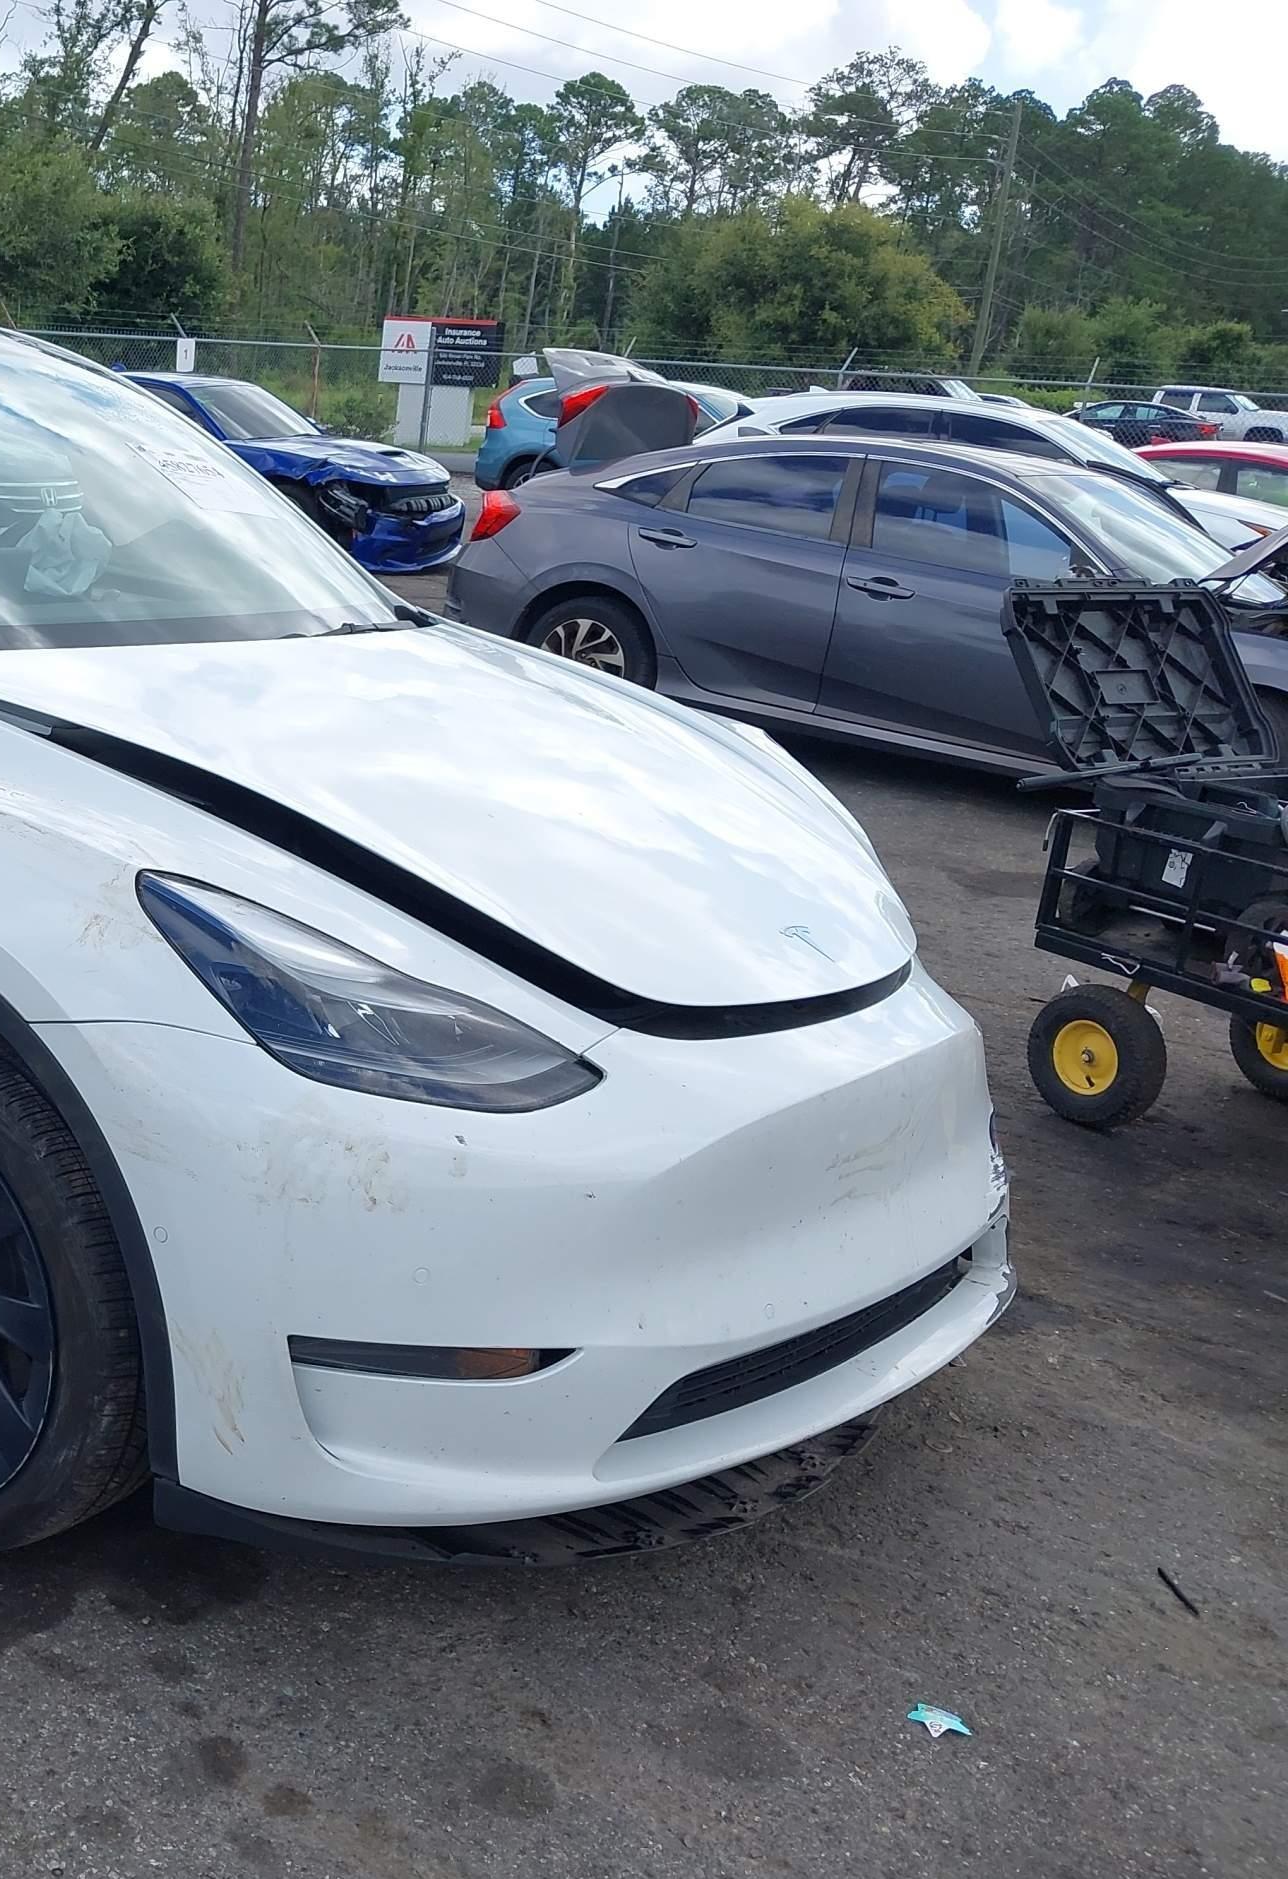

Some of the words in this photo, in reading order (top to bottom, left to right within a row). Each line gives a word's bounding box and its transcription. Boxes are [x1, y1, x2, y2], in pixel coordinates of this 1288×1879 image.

[445, 328, 481, 336] Insurance
[437, 337, 454, 345] Auto
[455, 338, 487, 346] Auctions
